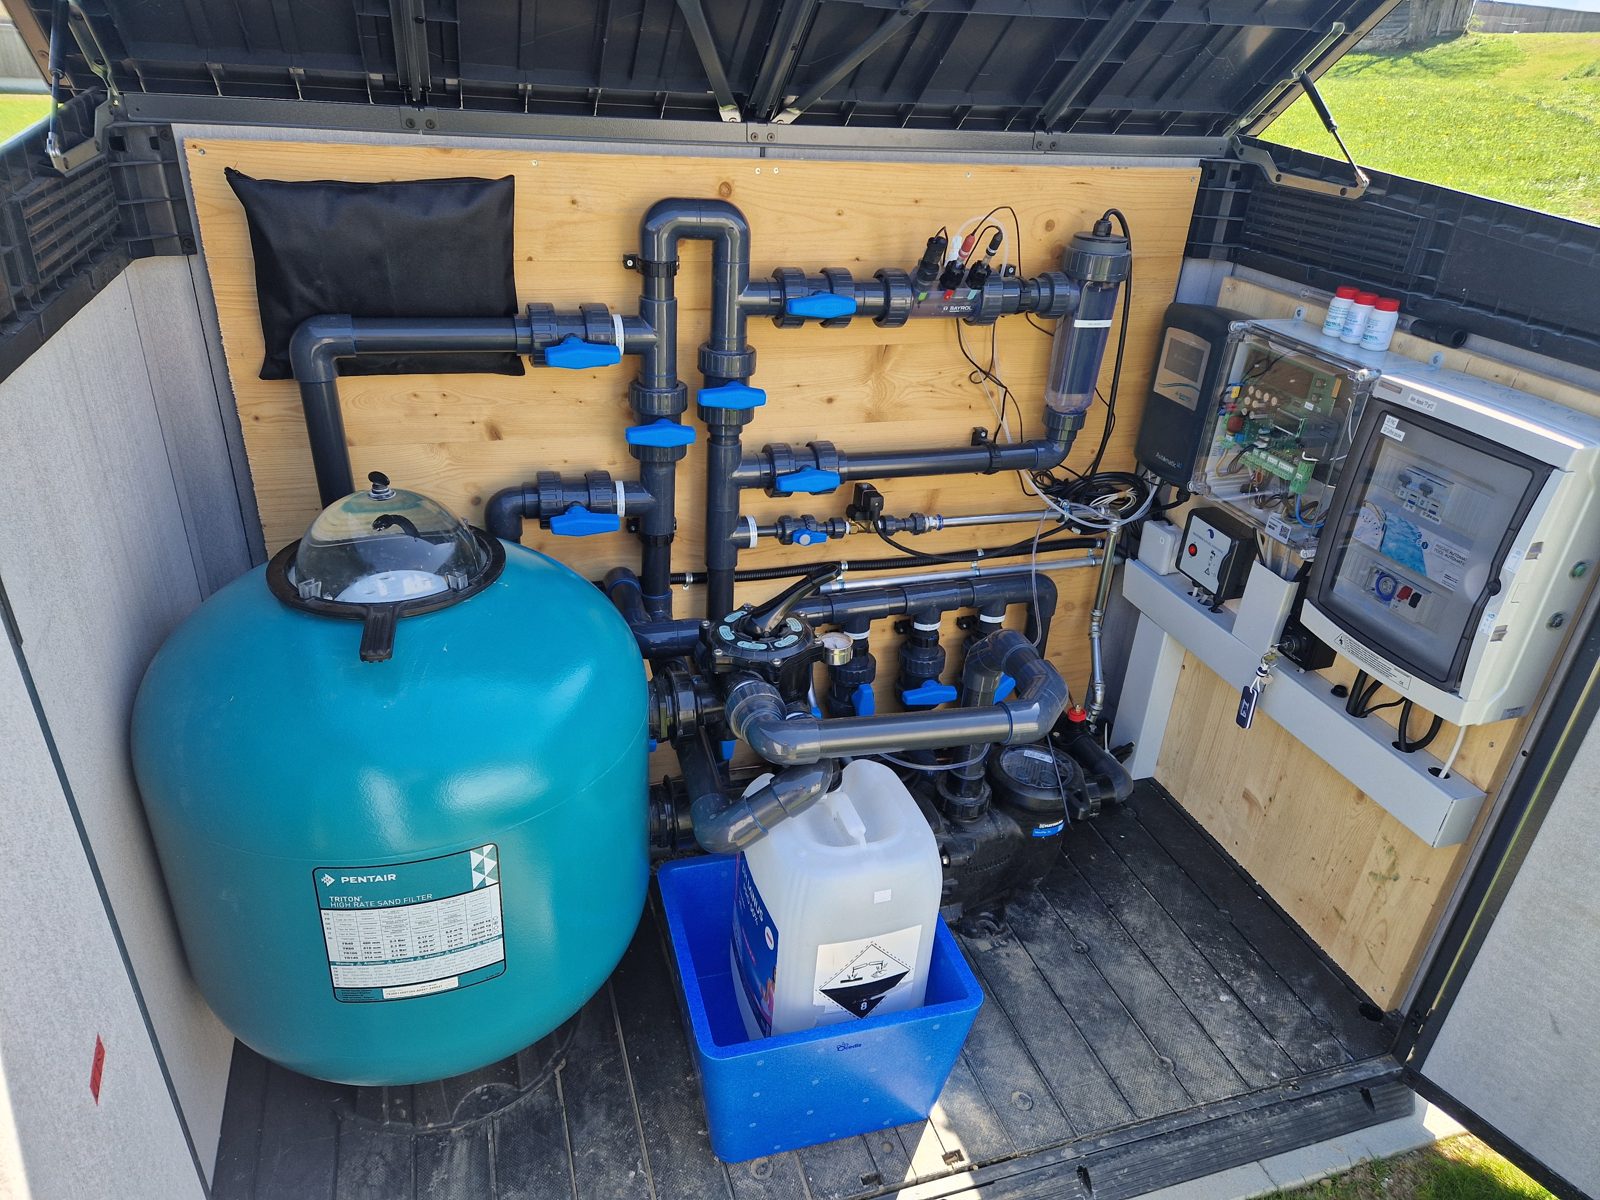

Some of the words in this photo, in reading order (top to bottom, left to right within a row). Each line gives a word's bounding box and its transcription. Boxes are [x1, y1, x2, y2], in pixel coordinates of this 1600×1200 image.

[341, 873, 397, 884] PENTAIR
[353, 900, 376, 908] RATE
[377, 898, 401, 907] SAND
[403, 893, 433, 904] FILTER
[860, 1001, 868, 1011] 8
